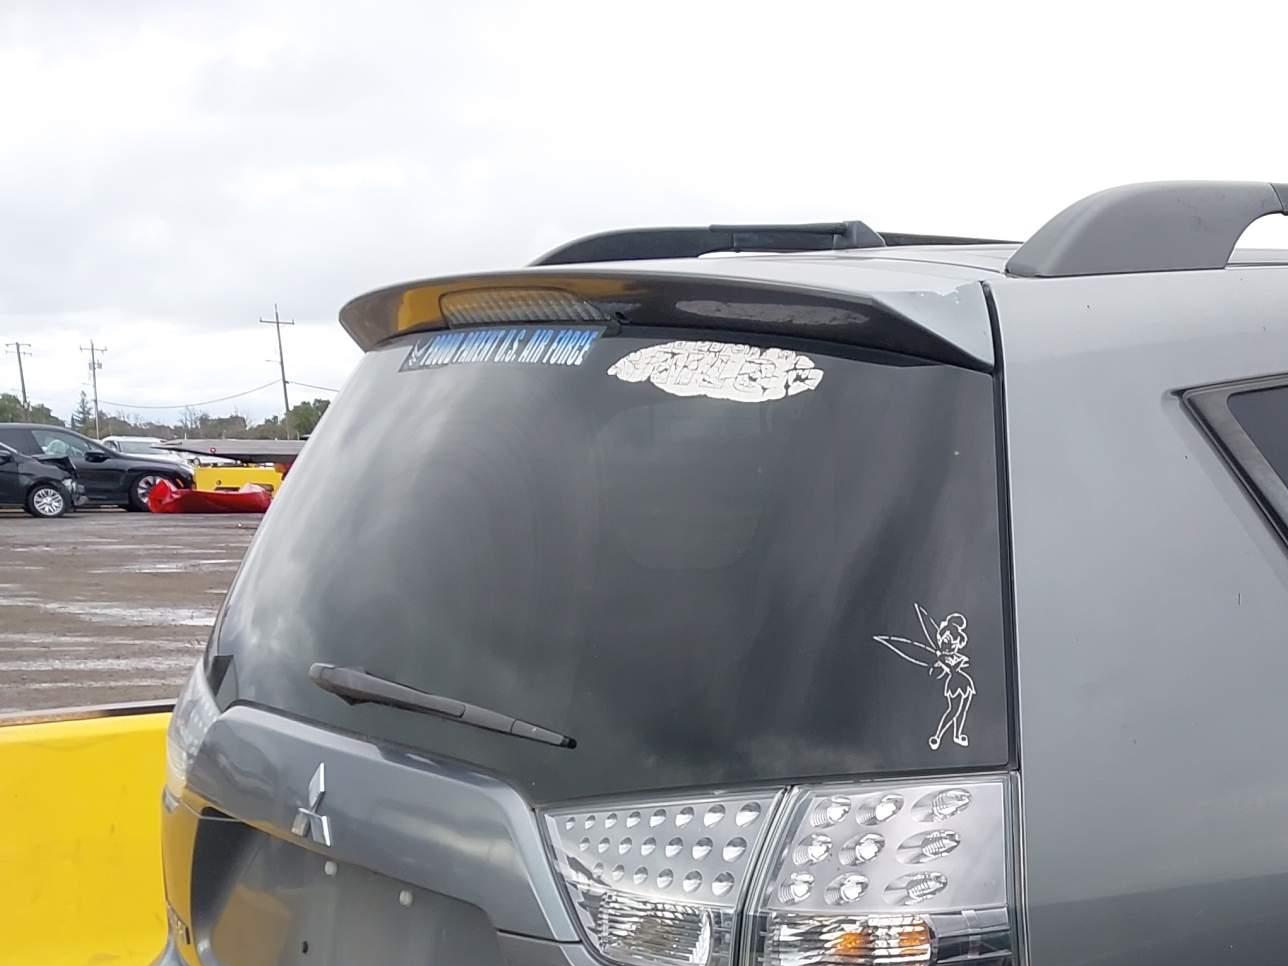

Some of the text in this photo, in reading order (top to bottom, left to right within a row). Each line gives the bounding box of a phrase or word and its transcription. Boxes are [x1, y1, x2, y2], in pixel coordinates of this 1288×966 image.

[453, 329, 506, 363] PARENT
[494, 329, 527, 362] U.S.
[518, 329, 554, 363] AIR
[542, 328, 599, 366] FORCE
